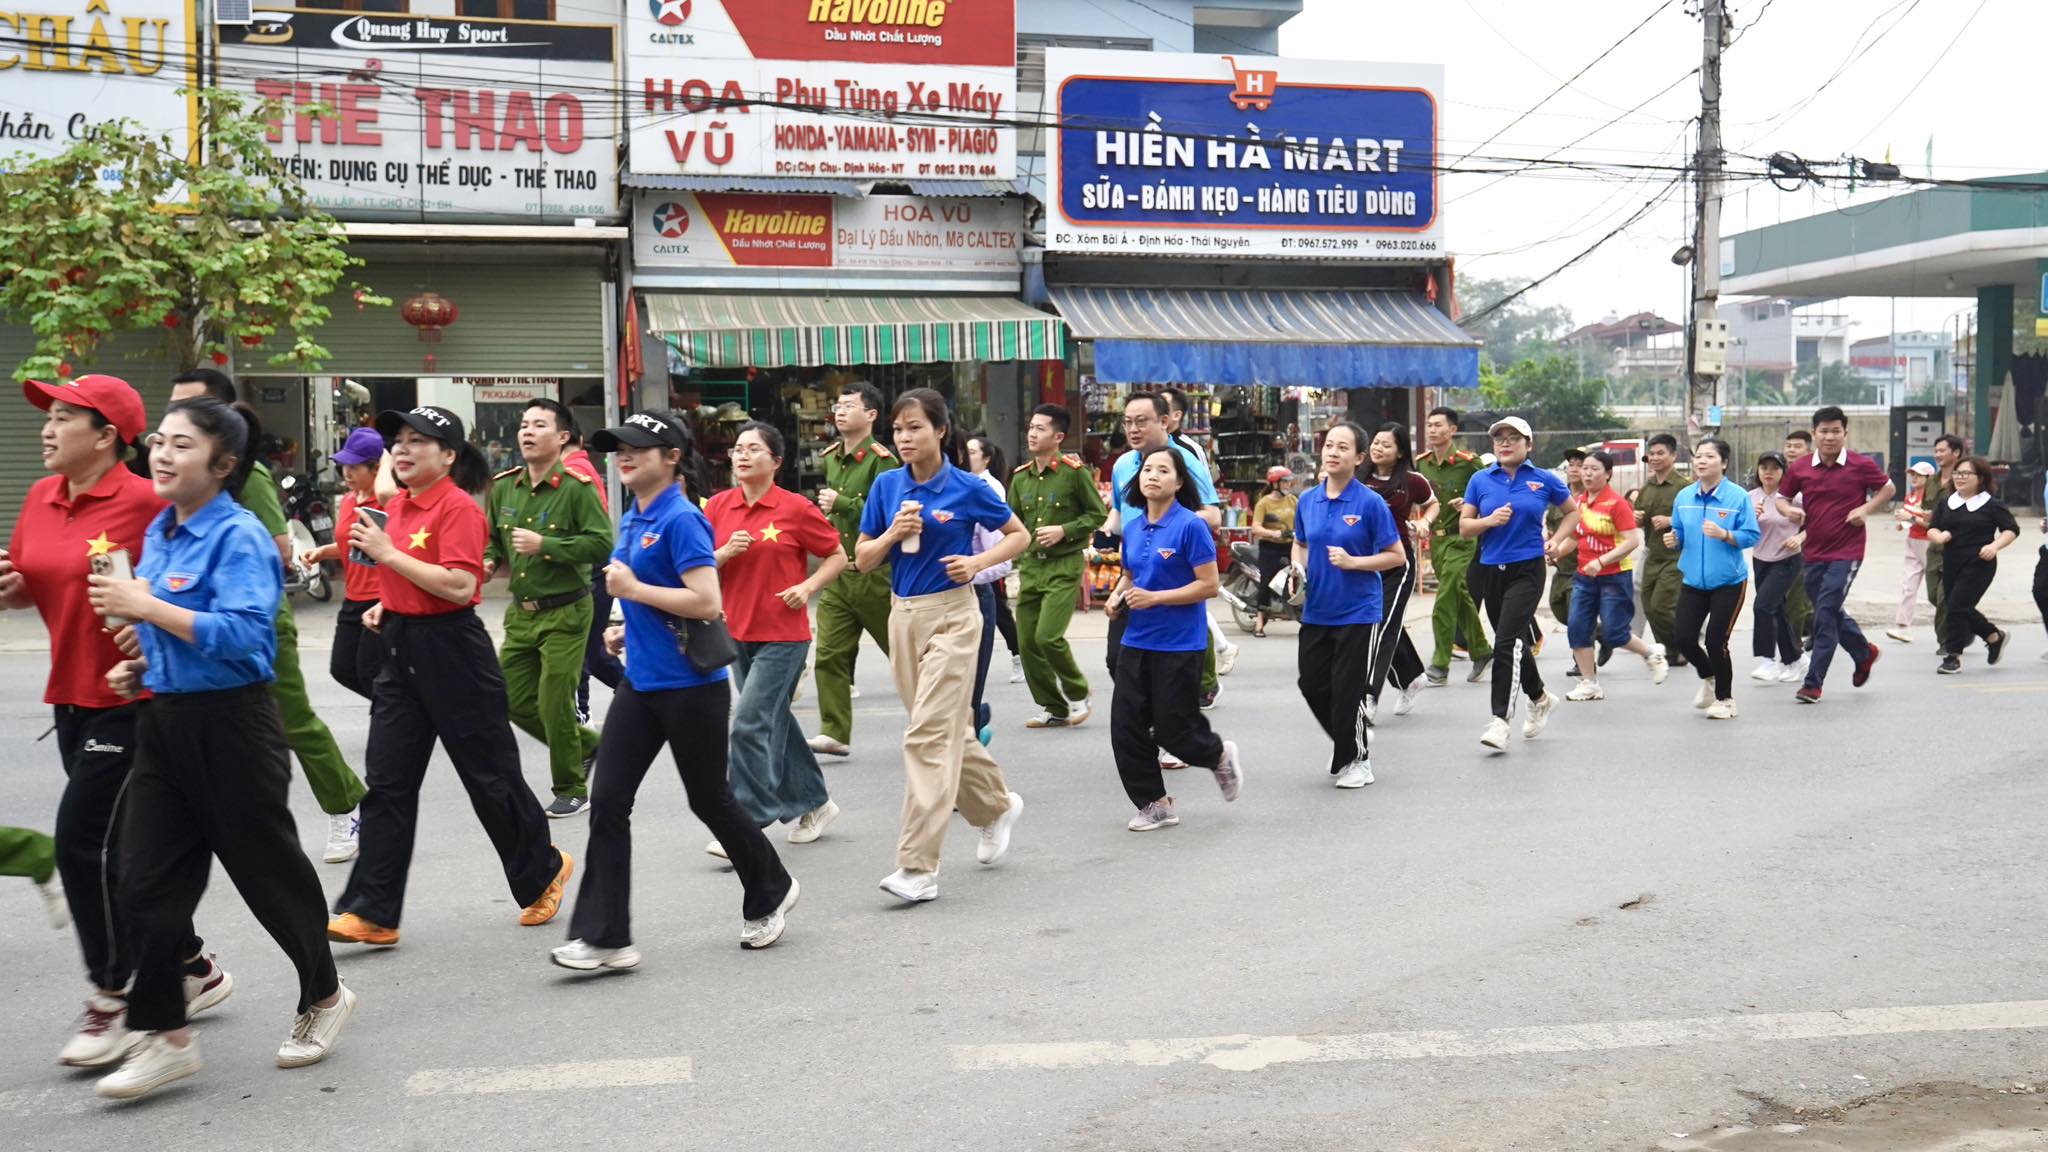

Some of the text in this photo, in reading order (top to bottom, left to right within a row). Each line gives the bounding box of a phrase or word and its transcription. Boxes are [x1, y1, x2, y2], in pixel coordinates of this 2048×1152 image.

[808, 0, 947, 27] Havoline
[357, 18, 509, 43] Quang Huy Sport
[650, 33, 694, 44] CALTEX
[825, 27, 847, 40] Dầu
[879, 29, 904, 43] Chất
[907, 32, 942, 46] Lượng
[1246, 73, 1263, 93] H
[255, 58, 584, 155] THỂ THAO
[834, 80, 898, 118] Tùng
[906, 81, 941, 112] Xe
[949, 82, 1003, 120] Máy
[0, 111, 54, 139] hẫn
[644, 78, 750, 166] HOA VŨ
[774, 124, 828, 150] HONDA
[834, 125, 898, 151] YAMAHA
[907, 127, 936, 153] SYM
[1096, 110, 1404, 173] HIỀN HÀ MART
[330, 160, 377, 187] DỤNG
[385, 162, 409, 189] CỤ
[416, 157, 452, 185] THỂ
[459, 165, 493, 191] DỤC
[514, 161, 547, 189] THỂ
[555, 169, 597, 190] THAO
[1082, 174, 1125, 209] SỮA
[1141, 178, 1195, 210] BÁNH
[1201, 185, 1239, 216] KẸO
[1258, 182, 1310, 213] HÀNG
[1316, 183, 1358, 214] TIÊU
[1365, 184, 1416, 216] DÙNG
[724, 208, 827, 236] Havoline
[884, 201, 972, 223] HOA VŨ
[653, 245, 690, 254] CALTEX
[798, 240, 826, 251] Lượng
[861, 229, 876, 250] Lý
[967, 231, 1017, 249] CALTEX
[1139, 235, 1160, 248] Định
[1214, 235, 1250, 249] Nguyên
[1298, 238, 1359, 249] 0967.572.999
[1375, 239, 1437, 251] 0963.020.666
